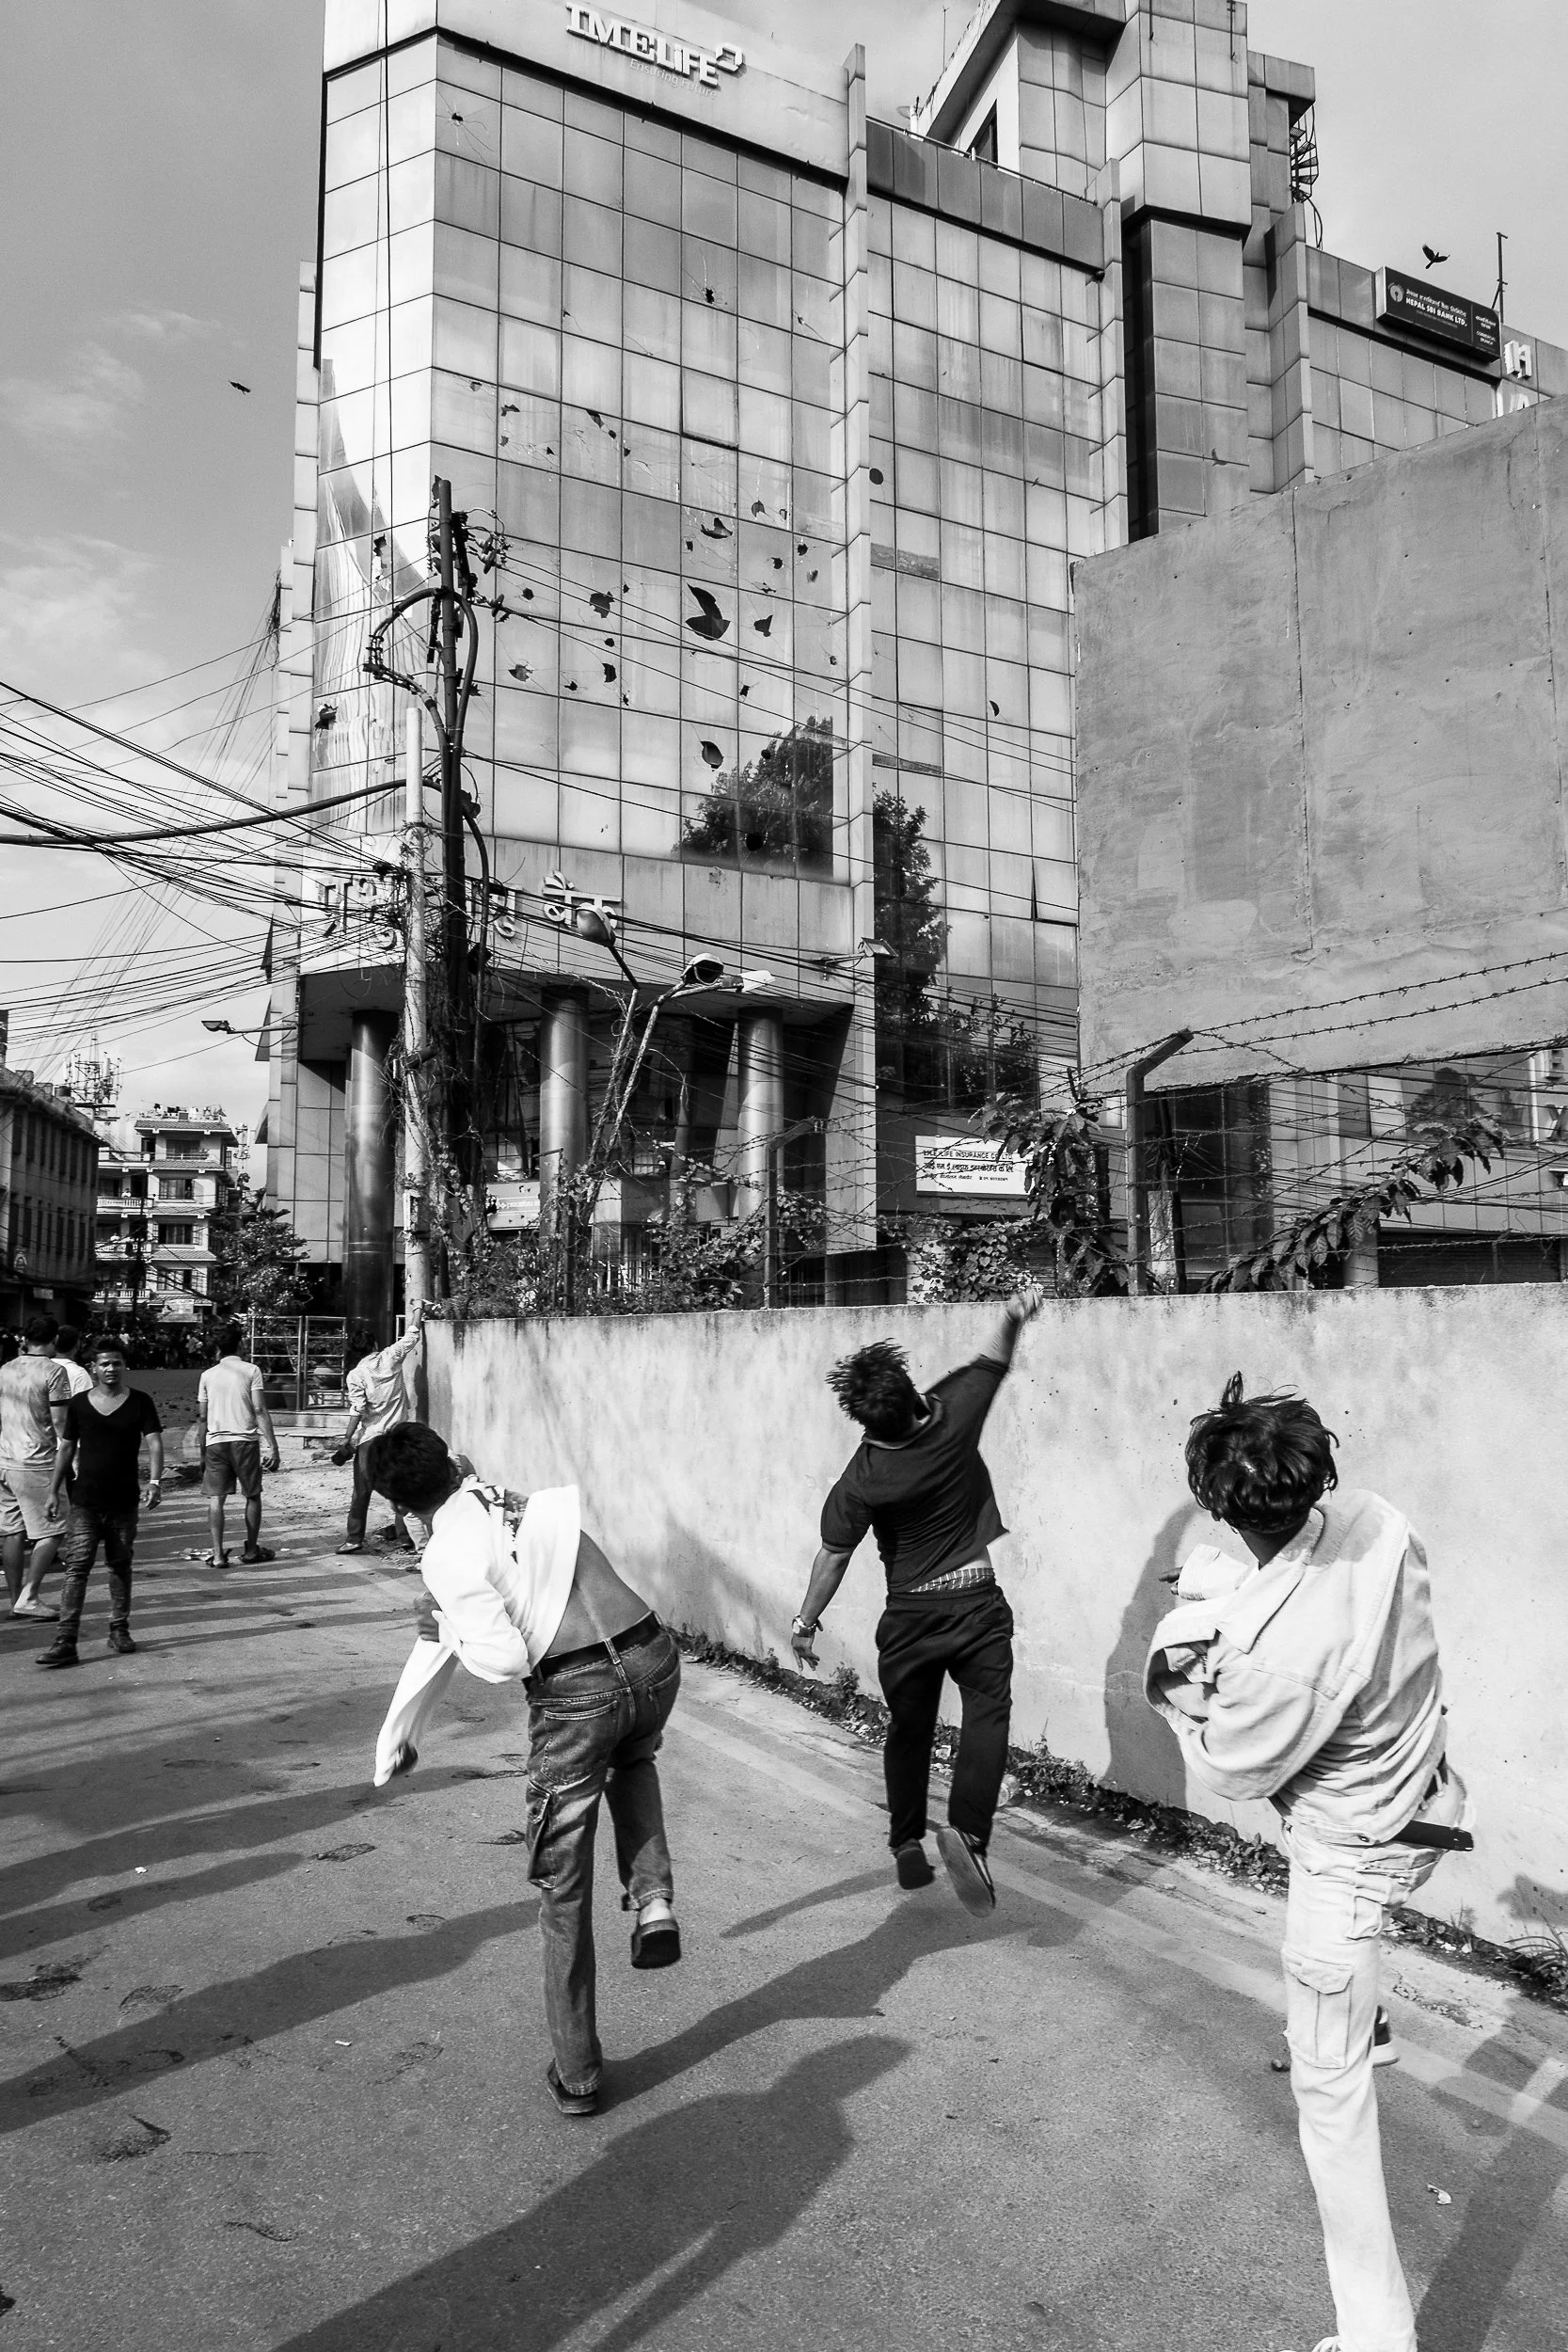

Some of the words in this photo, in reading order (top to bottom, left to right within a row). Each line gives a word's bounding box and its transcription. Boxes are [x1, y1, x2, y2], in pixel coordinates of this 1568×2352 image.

[629, 57, 678, 87] Ensuring
[681, 77, 717, 98] Future
[1405, 297, 1426, 310] NEPAL
[1426, 305, 1436, 314] SBI
[1436, 309, 1454, 322] BANK
[956, 1151, 989, 1160] INSURANCE
